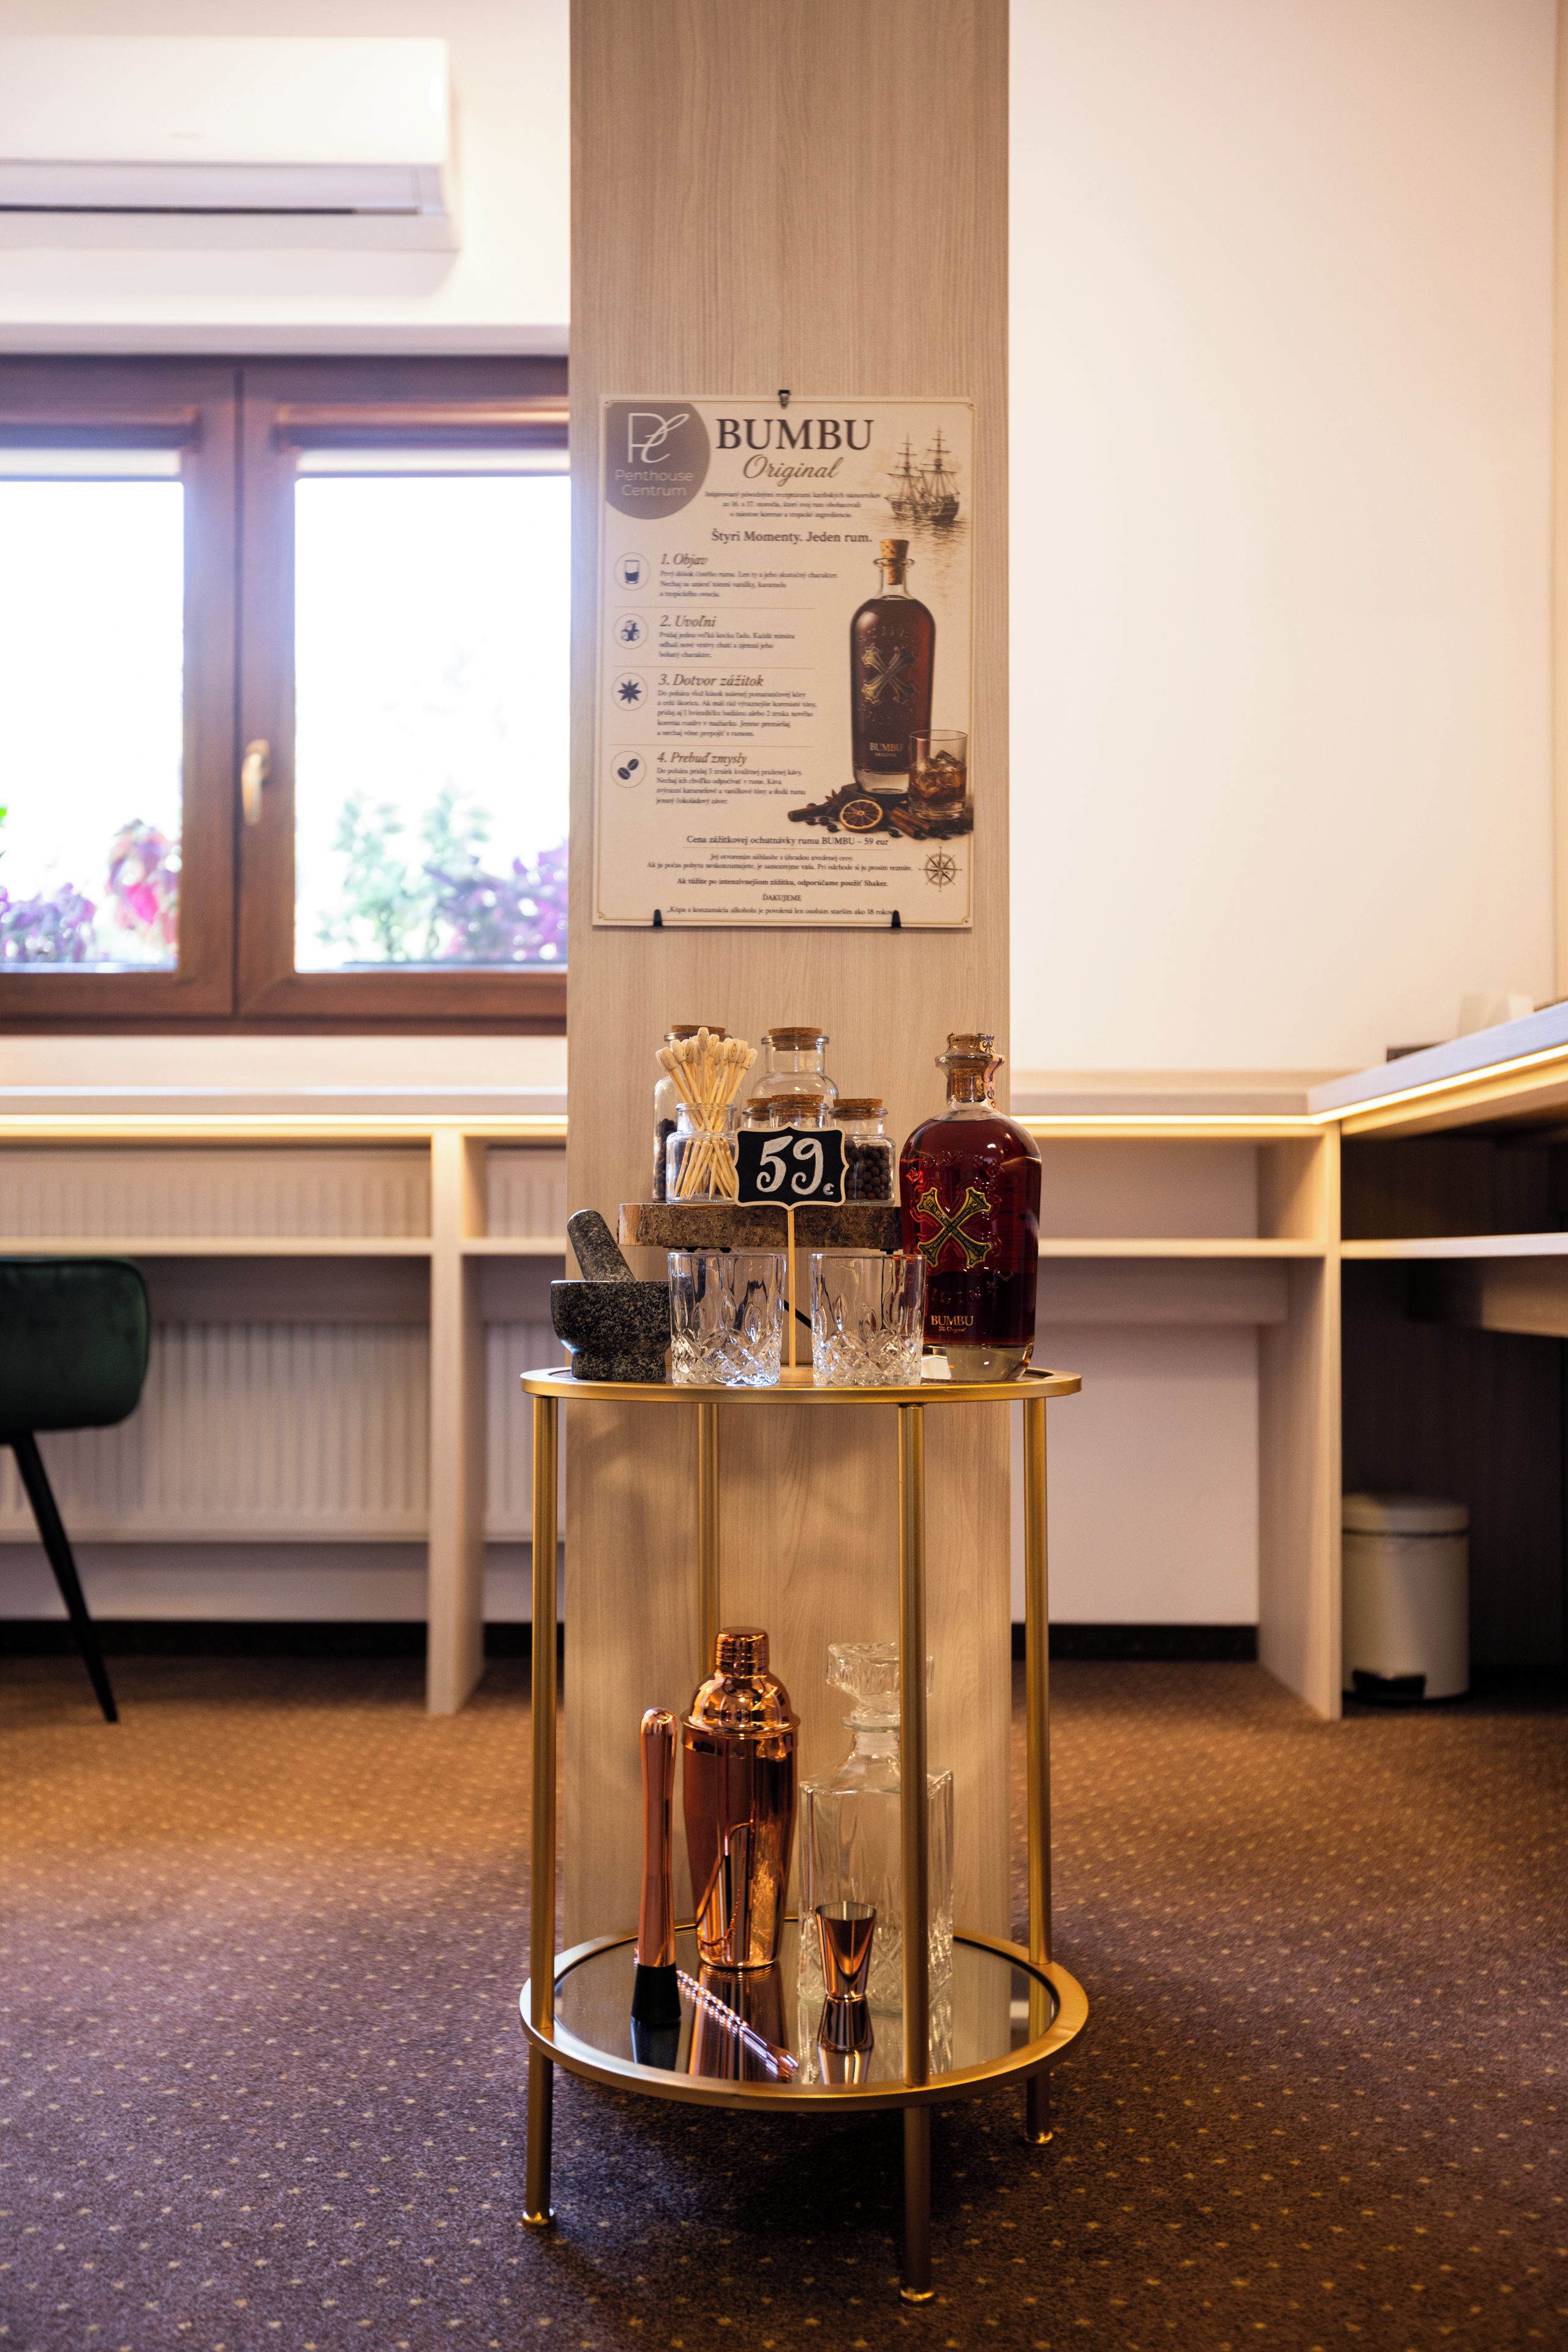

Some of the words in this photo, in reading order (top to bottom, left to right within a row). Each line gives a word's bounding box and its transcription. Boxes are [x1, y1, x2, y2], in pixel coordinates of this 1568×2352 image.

[715, 418, 875, 450] BUMBU
[615, 469, 694, 481] Penthouse
[743, 454, 844, 487] Original
[621, 484, 687, 496] Centrum
[712, 529, 741, 544] Štyri
[744, 531, 803, 544] Momenty.
[806, 532, 841, 541] Jeden
[661, 554, 670, 565] 1.
[673, 554, 708, 568] Objav
[658, 674, 669, 685] 3.
[673, 674, 718, 686] Dotvor
[720, 674, 764, 686] zážitok
[870, 742, 903, 752] BUMBU
[657, 752, 668, 762] 4.
[670, 752, 710, 763] Prebuď
[711, 753, 747, 767] zmysly
[709, 835, 748, 845] zážitkovej
[750, 836, 796, 846] ochutnávky
[756, 1136, 823, 1195] 59
[931, 1315, 974, 1326] BUMBU
